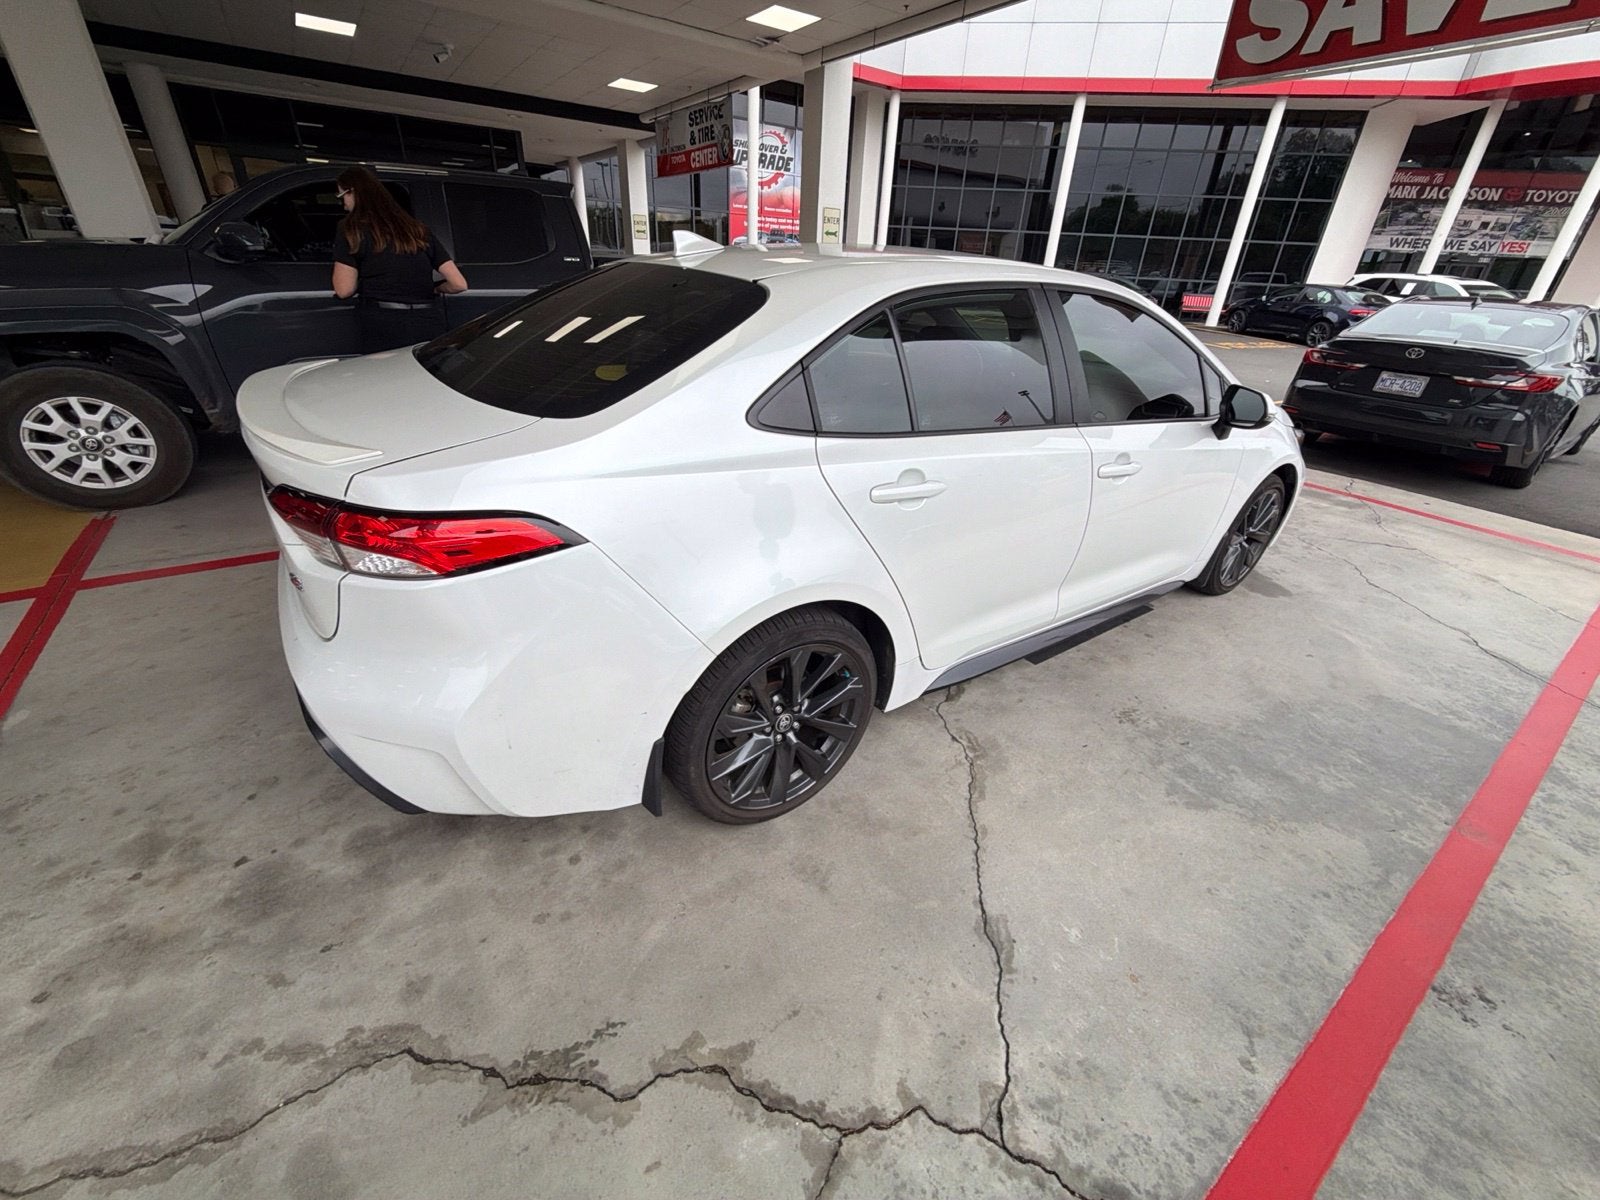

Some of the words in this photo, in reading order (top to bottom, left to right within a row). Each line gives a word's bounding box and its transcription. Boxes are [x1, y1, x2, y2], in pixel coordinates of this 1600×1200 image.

[689, 103, 724, 127] SERVICE
[690, 131, 696, 146] &
[698, 124, 715, 144] TIRE
[759, 143, 779, 153] OVER
[690, 146, 718, 169] CENTER
[1392, 172, 1430, 184] Welcome
[1433, 172, 1445, 184] To
[1525, 189, 1579, 204] TOYOT
[824, 216, 840, 224] ENTER
[1390, 237, 1432, 250] WHER
[1443, 239, 1467, 251] WE
[1469, 240, 1497, 252] SAY
[1501, 241, 1530, 253] YES!
